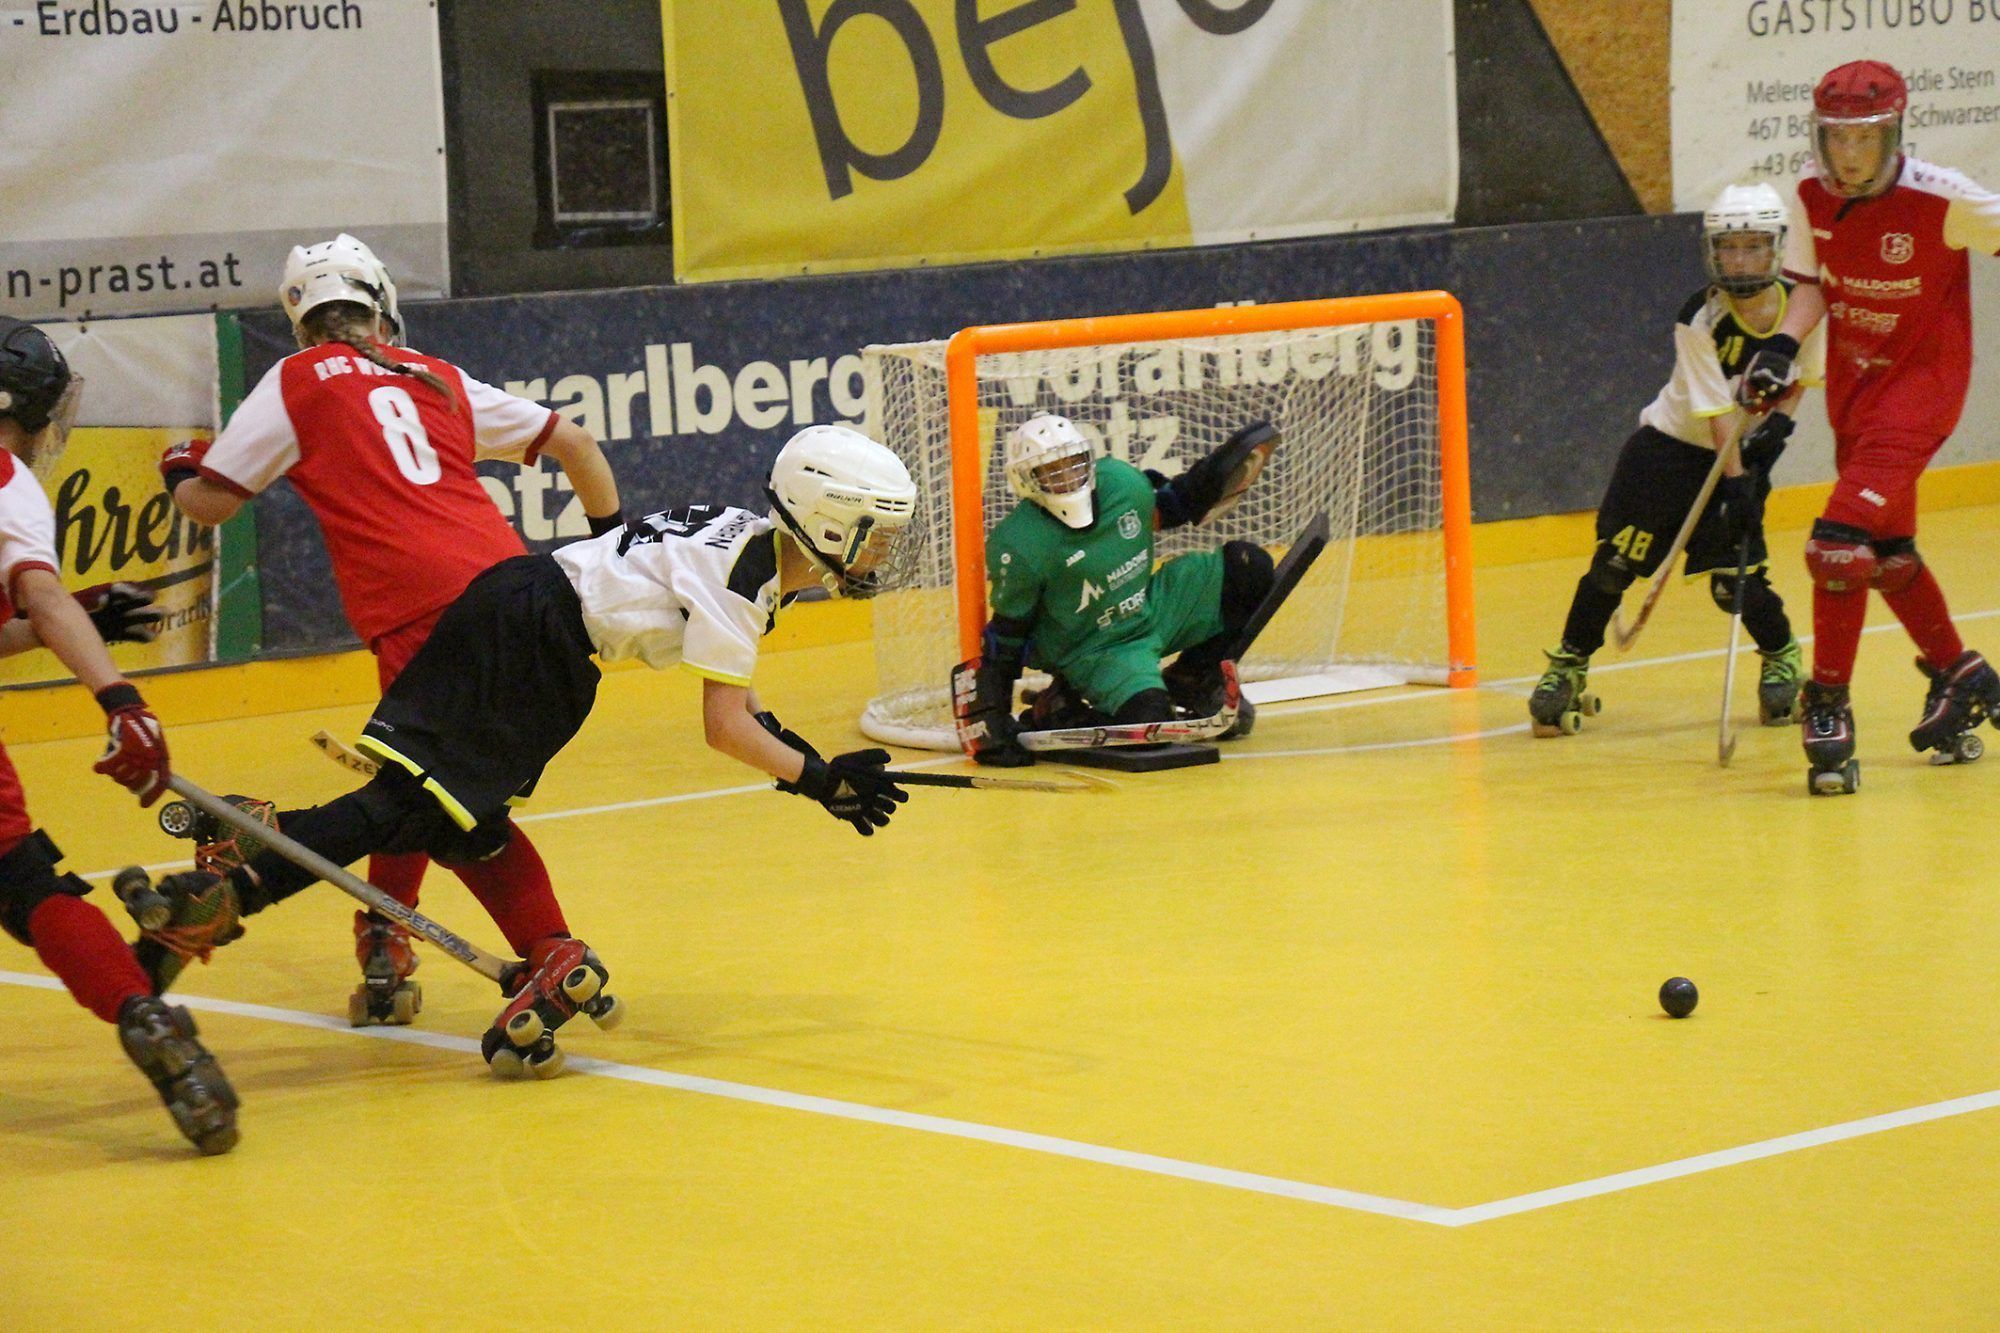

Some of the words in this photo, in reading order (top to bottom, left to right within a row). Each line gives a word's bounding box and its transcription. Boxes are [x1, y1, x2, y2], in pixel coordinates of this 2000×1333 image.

[38, 0, 179, 36] Erdbau
[212, 0, 363, 32] Abbruch
[1948, 66, 1995, 90] Stern
[1747, 116, 1782, 140] 467
[1750, 152, 1785, 176] +43
[0, 253, 243, 306] n-prast.at
[504, 341, 882, 443] arlberg
[368, 385, 442, 486] 8
[1612, 524, 1654, 561] 48
